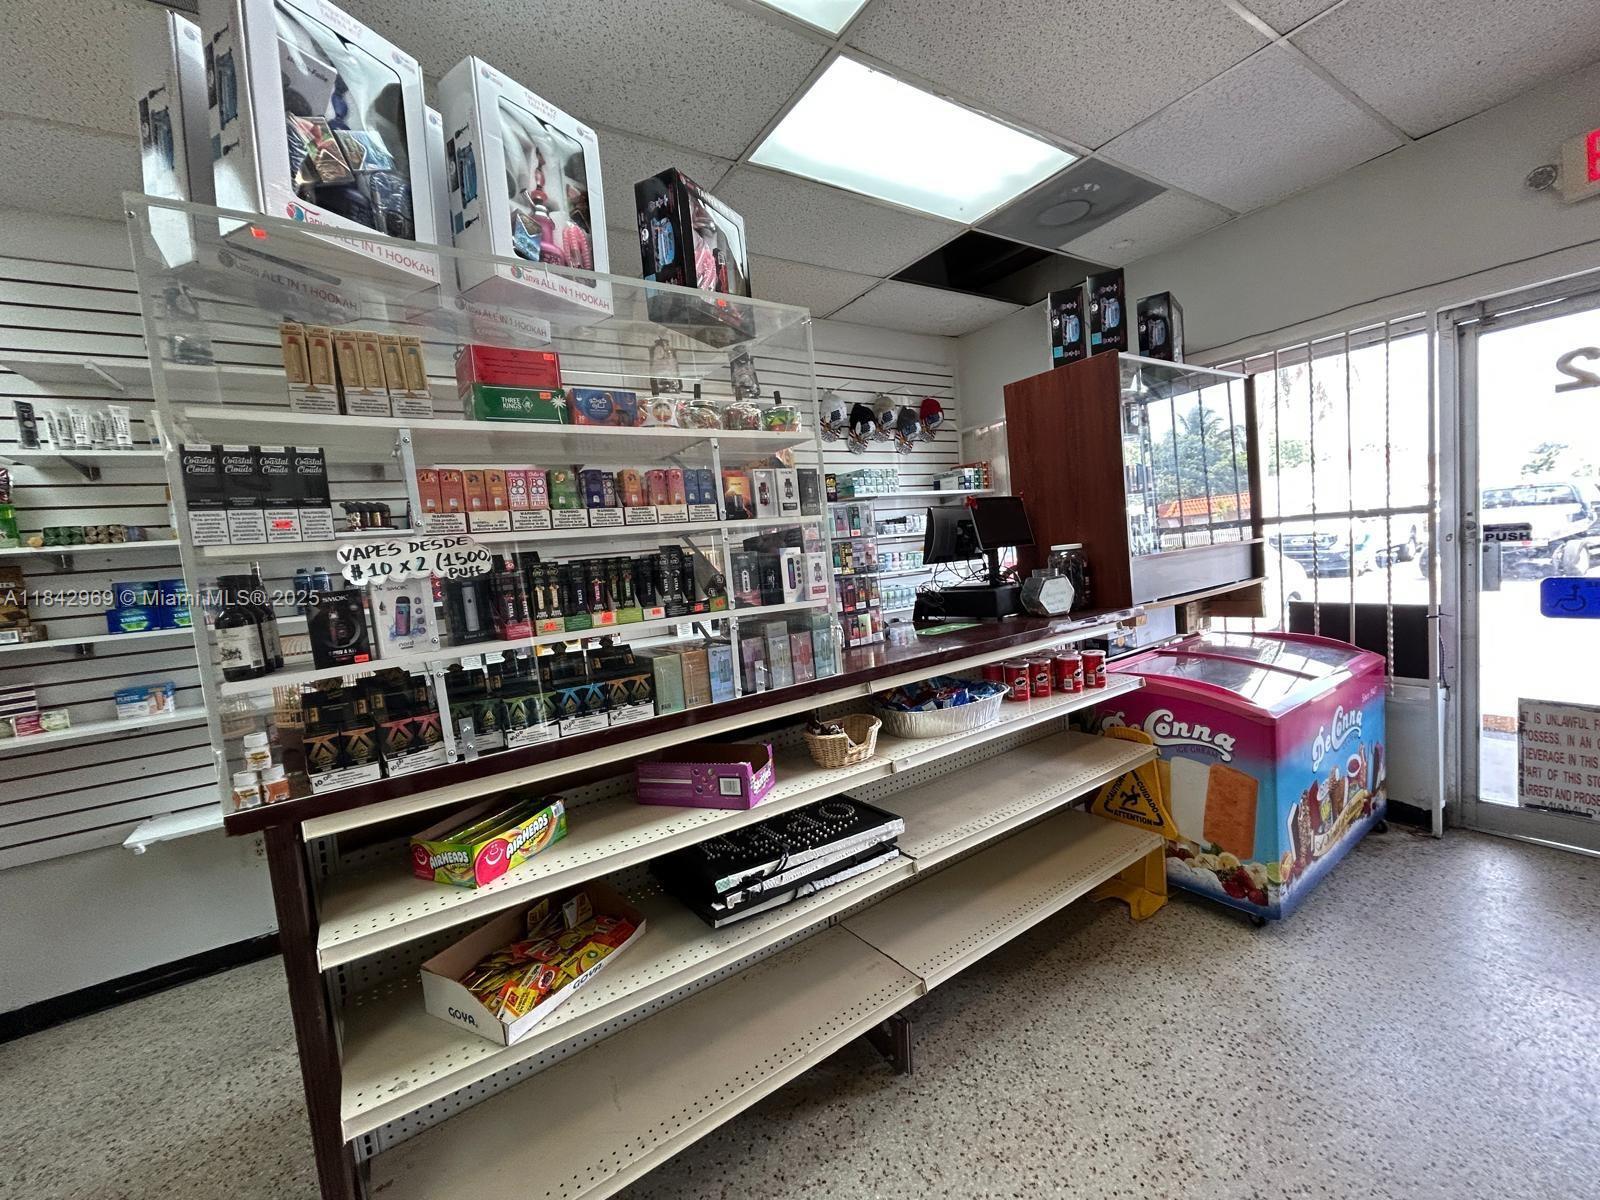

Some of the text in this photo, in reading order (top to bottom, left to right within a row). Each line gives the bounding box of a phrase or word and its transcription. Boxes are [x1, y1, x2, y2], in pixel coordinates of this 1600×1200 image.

[361, 239, 374, 254] IN
[385, 249, 435, 277] HOOKAH
[540, 279, 557, 292] ALL
[559, 286, 568, 295] IN
[575, 290, 610, 310] HOOKAH
[183, 456, 216, 465] Coastal
[222, 456, 254, 465] Coastal
[259, 456, 289, 466] Coastal
[294, 456, 323, 466] Coastal
[185, 465, 216, 473] Clouds
[224, 465, 253, 473] Clouds
[261, 465, 289, 474] Clouds
[296, 465, 323, 474] Clouds
[1484, 532, 1531, 543] PUSH
[339, 536, 469, 563] VAPES DESDE
[416, 556, 430, 572] 2
[1533, 712, 1542, 725] IS
[1546, 713, 1590, 730] UNLAWFUL
[1567, 735, 1576, 747] IN
[1579, 736, 1592, 750] AN
[1568, 754, 1577, 767] IN
[1580, 755, 1599, 769] THIS
[1547, 768, 1559, 781] OF
[1563, 771, 1582, 785] THIS
[1136, 780, 1159, 813] CUIDADO
[1555, 788, 1572, 801] AND
[1113, 808, 1154, 826] ATTENTION
[506, 813, 549, 860] AIRHEADS
[429, 850, 470, 870] AIRHEADS
[573, 962, 604, 990] GOYA
[448, 1006, 478, 1027] GOYA
